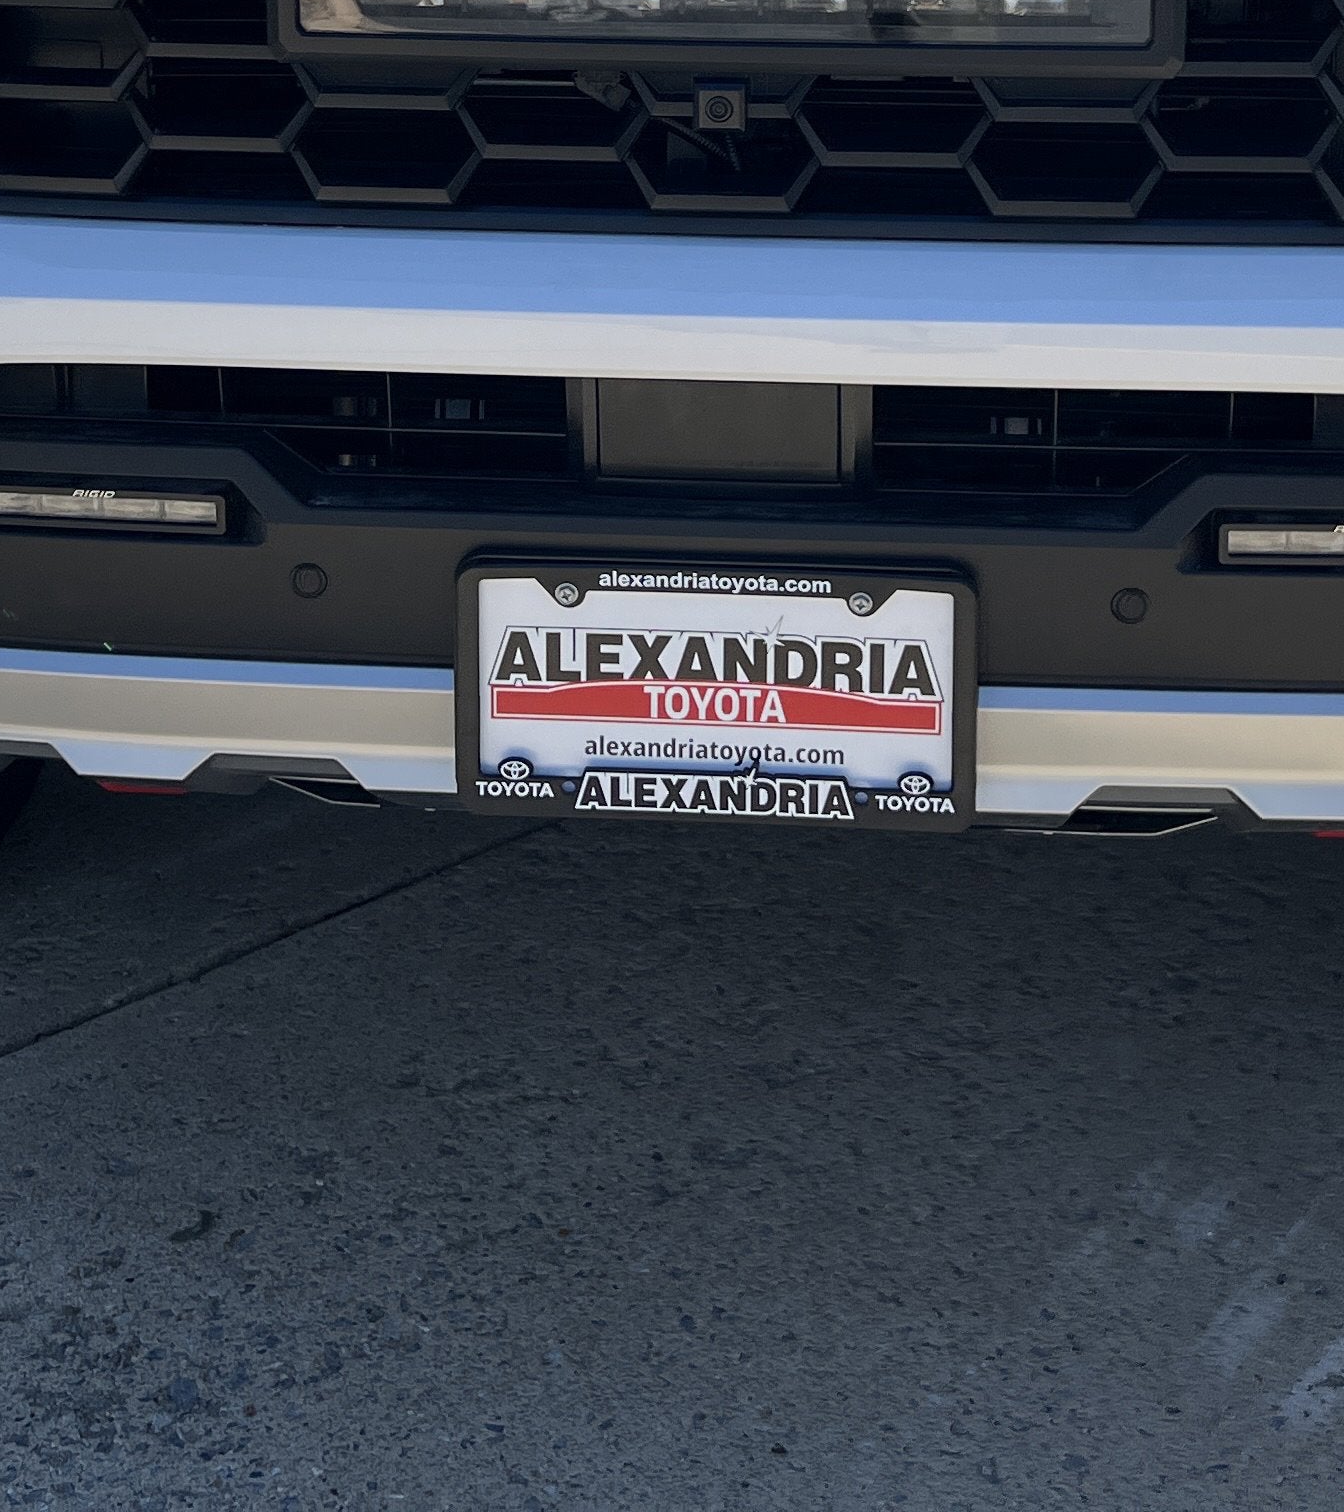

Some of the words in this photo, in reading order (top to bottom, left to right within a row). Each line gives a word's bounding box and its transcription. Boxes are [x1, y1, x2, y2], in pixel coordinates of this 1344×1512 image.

[598, 570, 832, 594] alexandriatoyota.com
[492, 629, 939, 698] ALEXANDRIA
[643, 685, 787, 723] TOYOTA
[584, 736, 845, 767] alexandriatoyota.com
[476, 780, 555, 799] TOYOTA
[575, 771, 854, 819] ALEXANDRIA
[874, 794, 955, 814] TOYOTA
